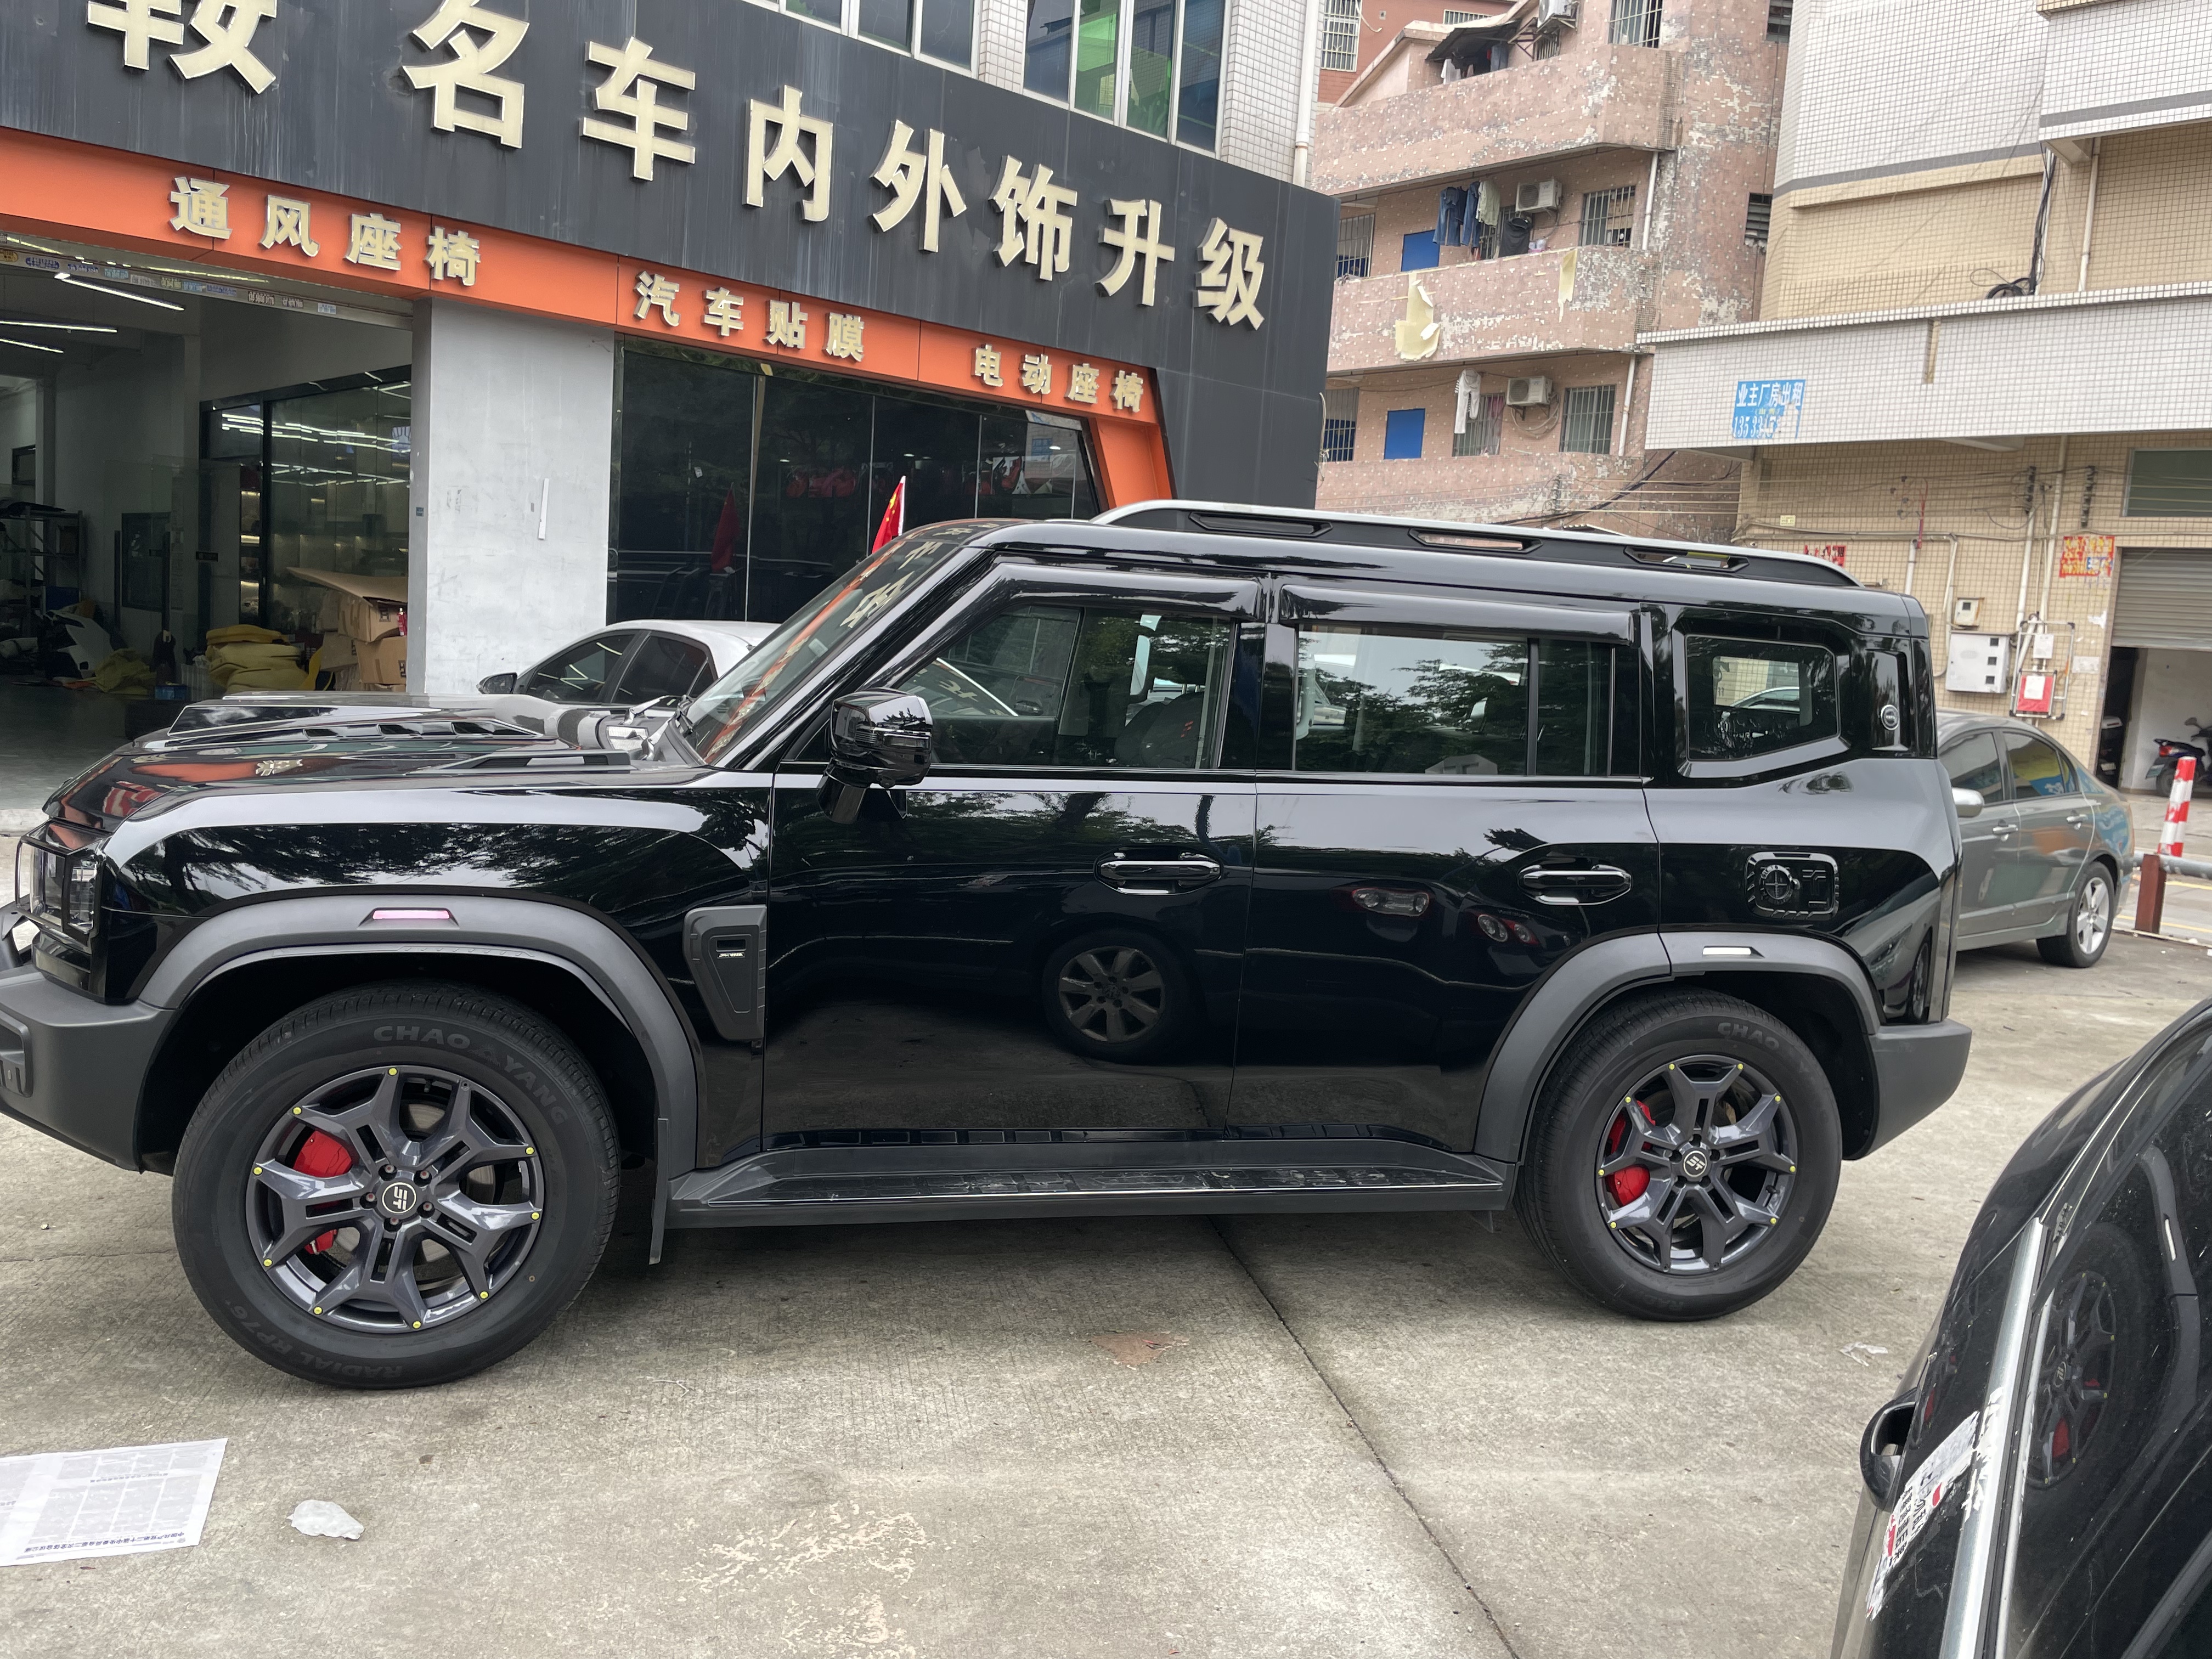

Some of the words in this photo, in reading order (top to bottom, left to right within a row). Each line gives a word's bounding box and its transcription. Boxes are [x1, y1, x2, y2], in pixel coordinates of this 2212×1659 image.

[400, 0, 1265, 330] 名车内外饰升级
[169, 176, 481, 287] 通风座椅
[634, 270, 865, 363] 汽车贴膜
[972, 343, 1144, 414] 电动座椅
[1736, 382, 1803, 407] 业主厂房出租
[373, 1025, 471, 1049] CHAO
[504, 1054, 568, 1126] YANG
[300, 1351, 403, 1378] RADIAL
